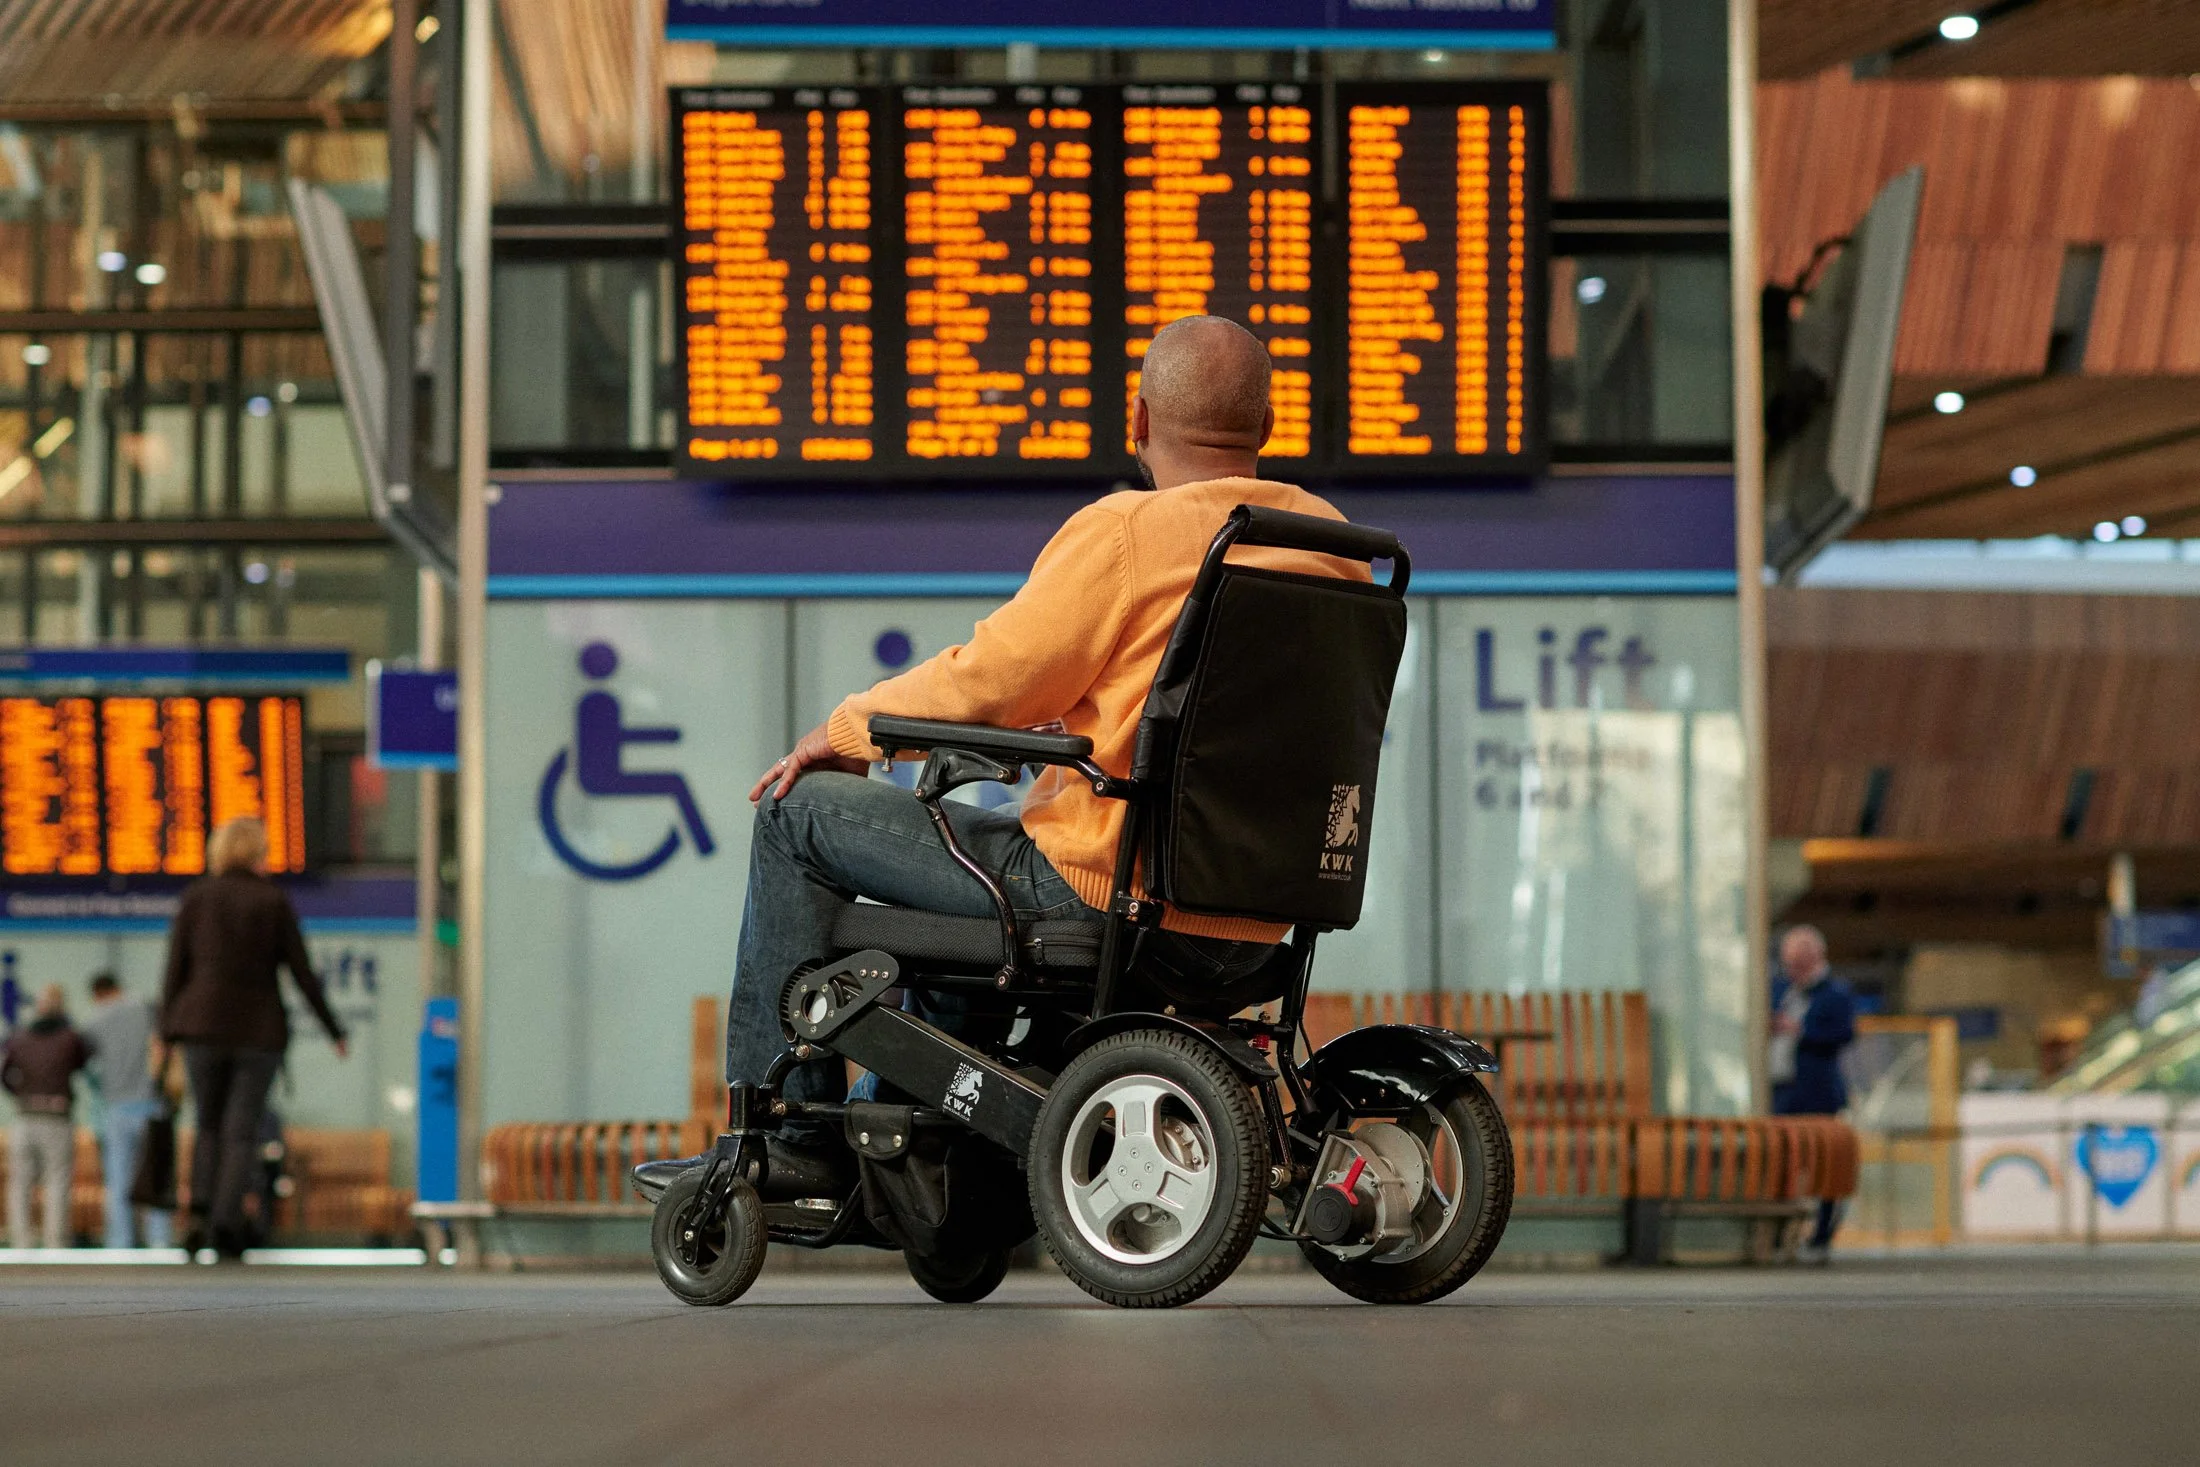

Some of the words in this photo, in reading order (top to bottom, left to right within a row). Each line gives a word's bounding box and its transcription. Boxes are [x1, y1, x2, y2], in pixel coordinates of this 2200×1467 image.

[1475, 626, 1656, 711] Lift
[1320, 853, 1354, 872] KWK
[943, 1094, 974, 1117] KWK
